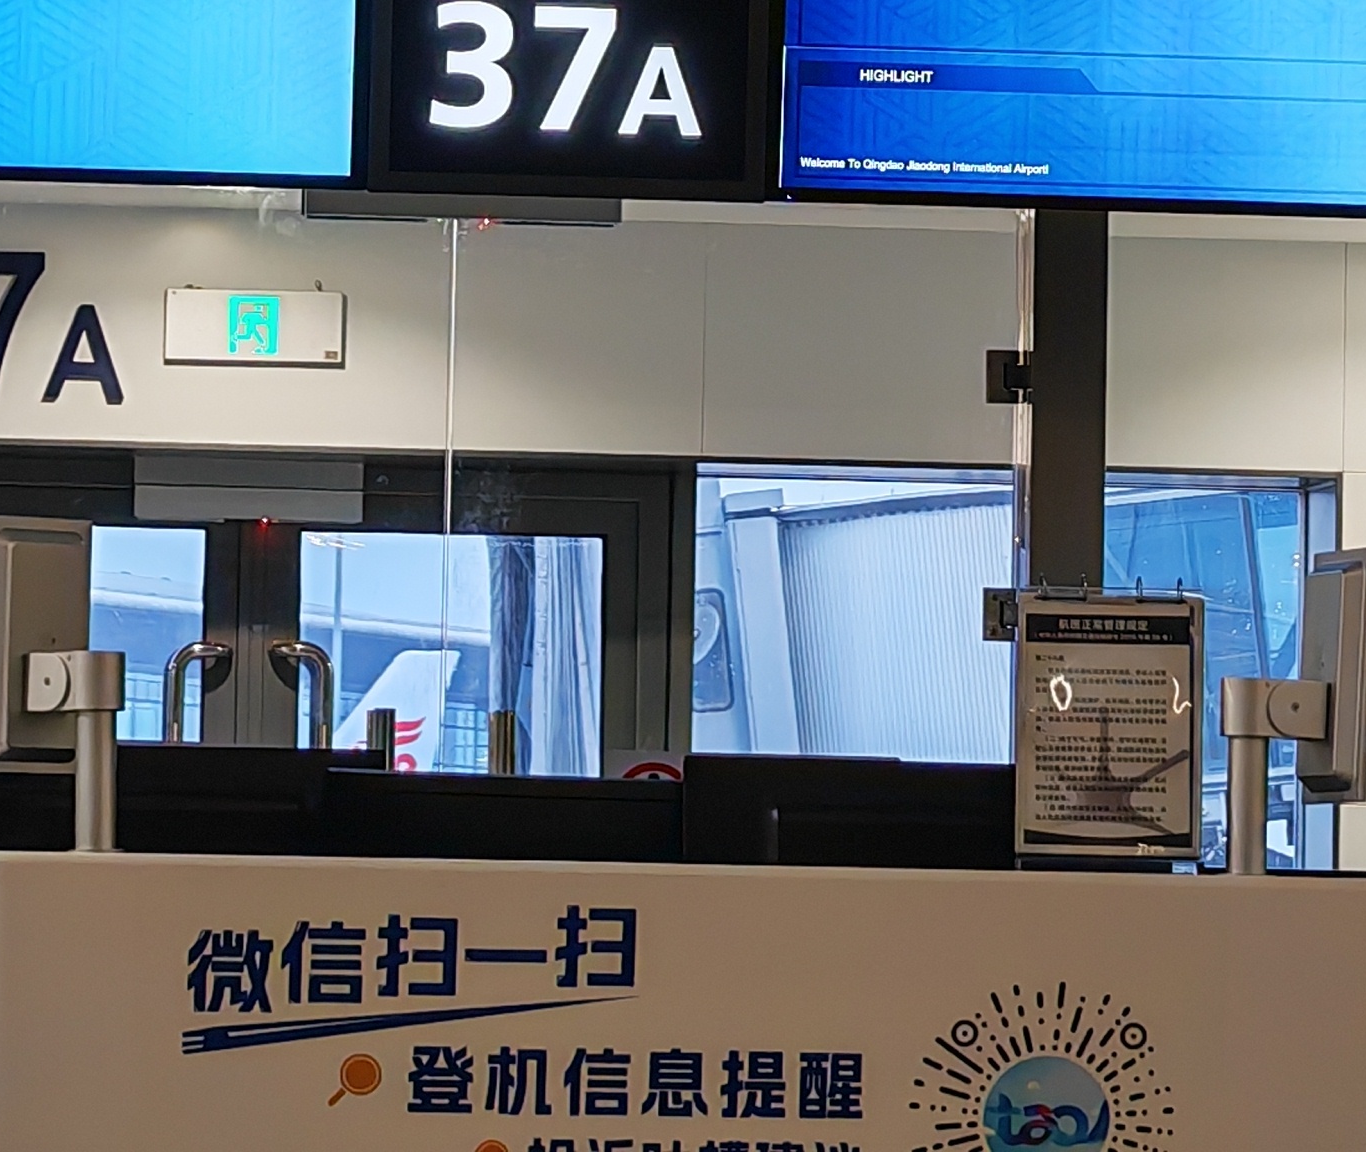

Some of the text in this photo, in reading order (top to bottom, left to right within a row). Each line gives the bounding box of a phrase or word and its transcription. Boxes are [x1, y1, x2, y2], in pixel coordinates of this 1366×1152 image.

[428, 0, 703, 138] 37A
[859, 69, 935, 84] HIGHLIGHT
[800, 157, 846, 169] Welcome
[847, 158, 861, 169] To
[863, 158, 905, 173] Qingdao
[906, 160, 951, 174] Jiaodong
[952, 161, 1012, 174] International
[186, 904, 637, 1013] 微信扫一扫
[407, 1045, 864, 1119] 登机信息提醒
